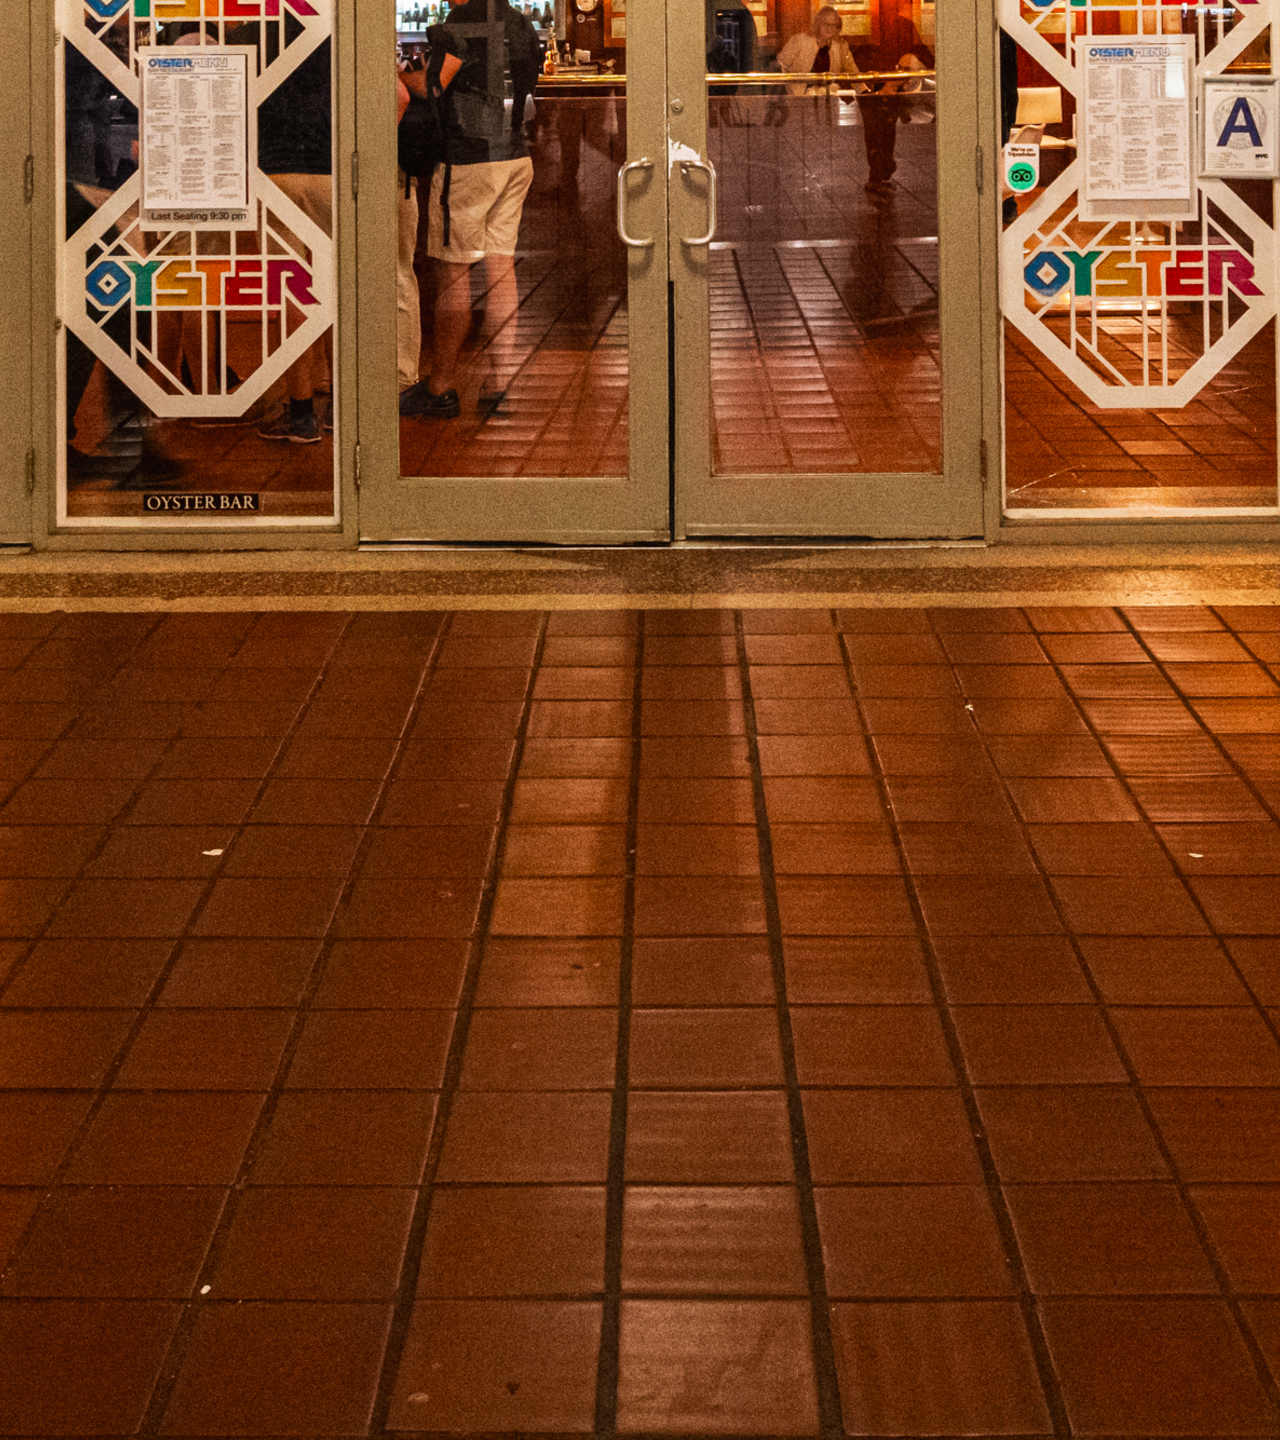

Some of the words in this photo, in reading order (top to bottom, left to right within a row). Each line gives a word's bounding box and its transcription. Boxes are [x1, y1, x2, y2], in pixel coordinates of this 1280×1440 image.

[1089, 47, 1134, 58] OYSTER
[148, 57, 193, 68] OYSTER
[1217, 97, 1263, 147] A
[151, 212, 171, 221] Last
[173, 211, 208, 222] Seating
[210, 211, 230, 221] 9:30
[231, 213, 247, 222] pm
[1024, 250, 1265, 297] OYSTER
[85, 260, 322, 307] OYSTER
[147, 495, 216, 510] OYSTER
[219, 495, 255, 509] BAR
